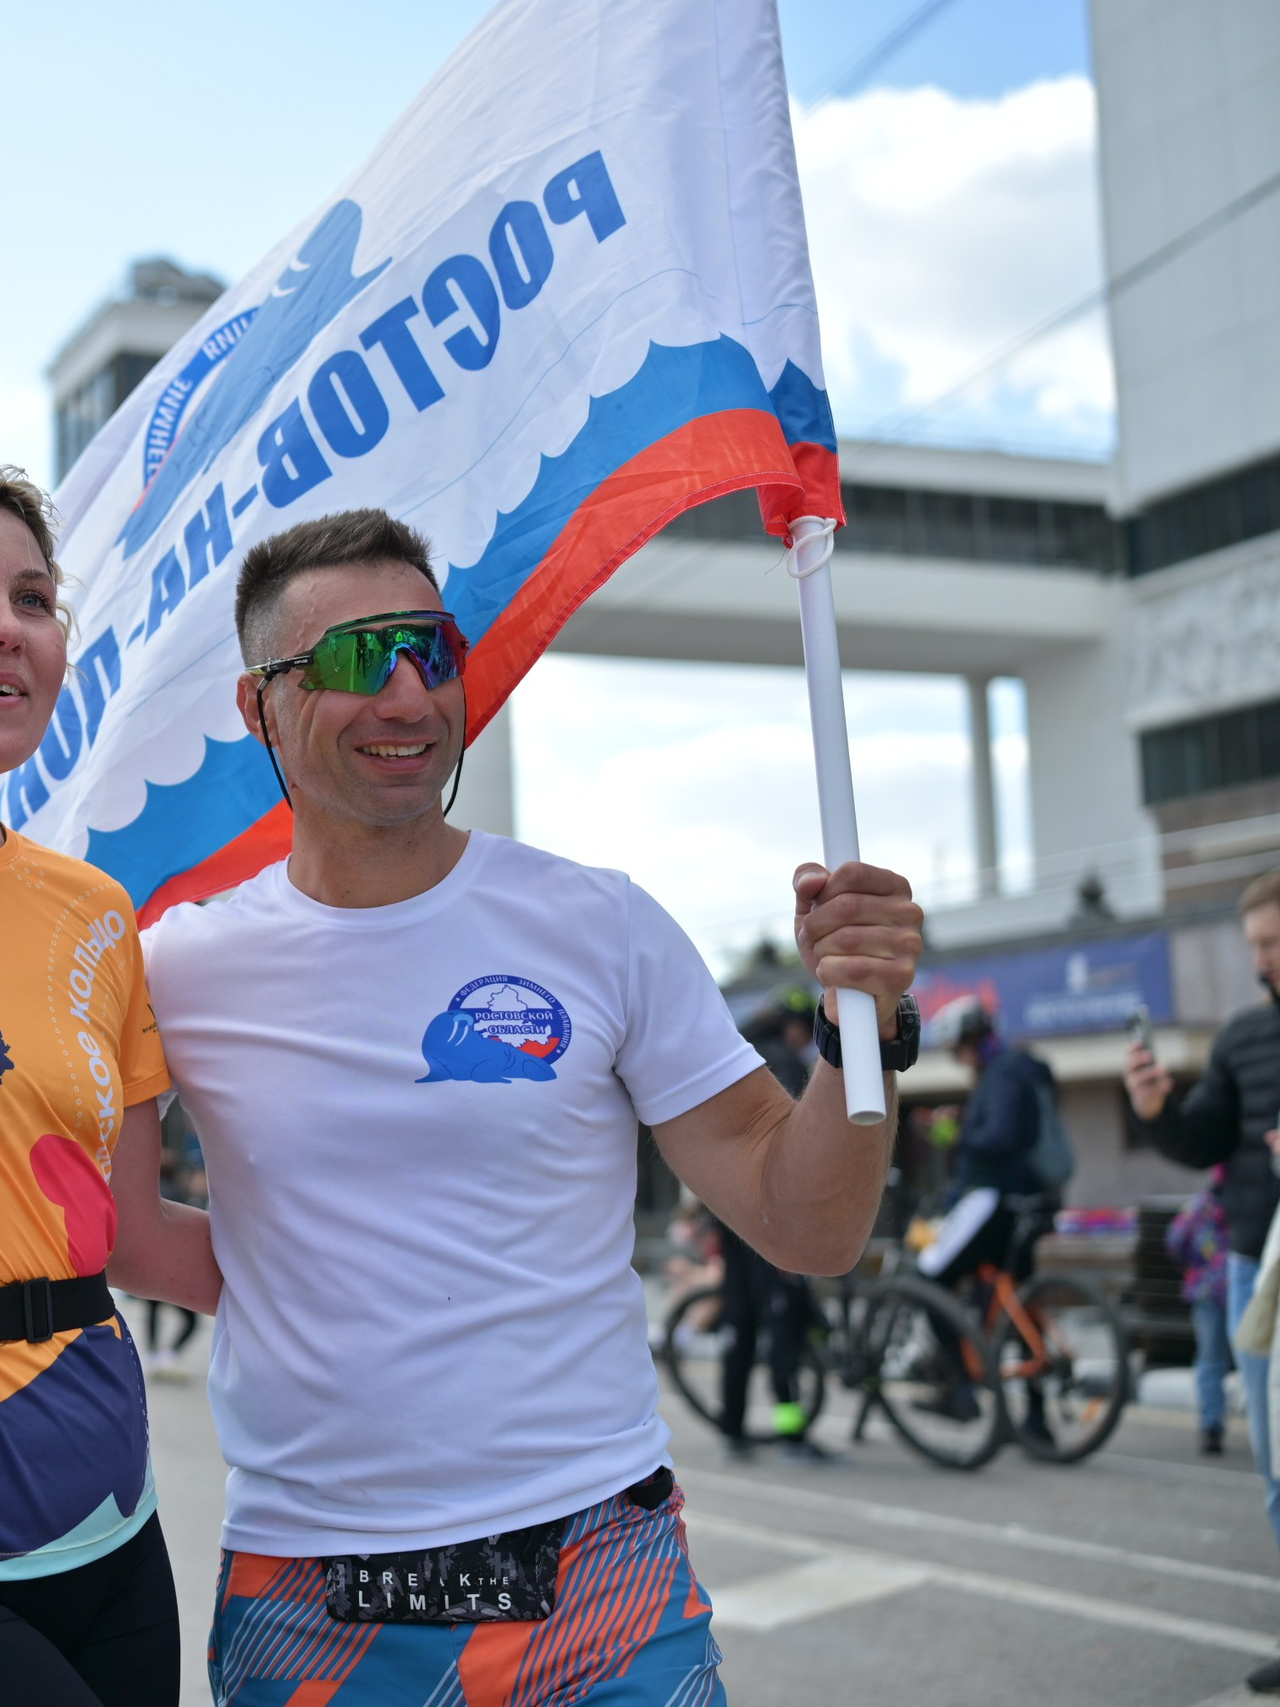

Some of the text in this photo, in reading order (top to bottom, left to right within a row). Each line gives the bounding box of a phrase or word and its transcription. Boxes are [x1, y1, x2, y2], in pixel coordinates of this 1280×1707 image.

[460, 975, 570, 1049] ФЕДЕРАЦИЯ ЗИМНЕГО ПЛАВАНИЯ
[475, 1010, 554, 1021] РОСТОВСКОЙ
[488, 1025, 546, 1035] ОБЛАСТИ
[478, 1576, 510, 1586] THE
[358, 1590, 513, 1611] LIMITS
